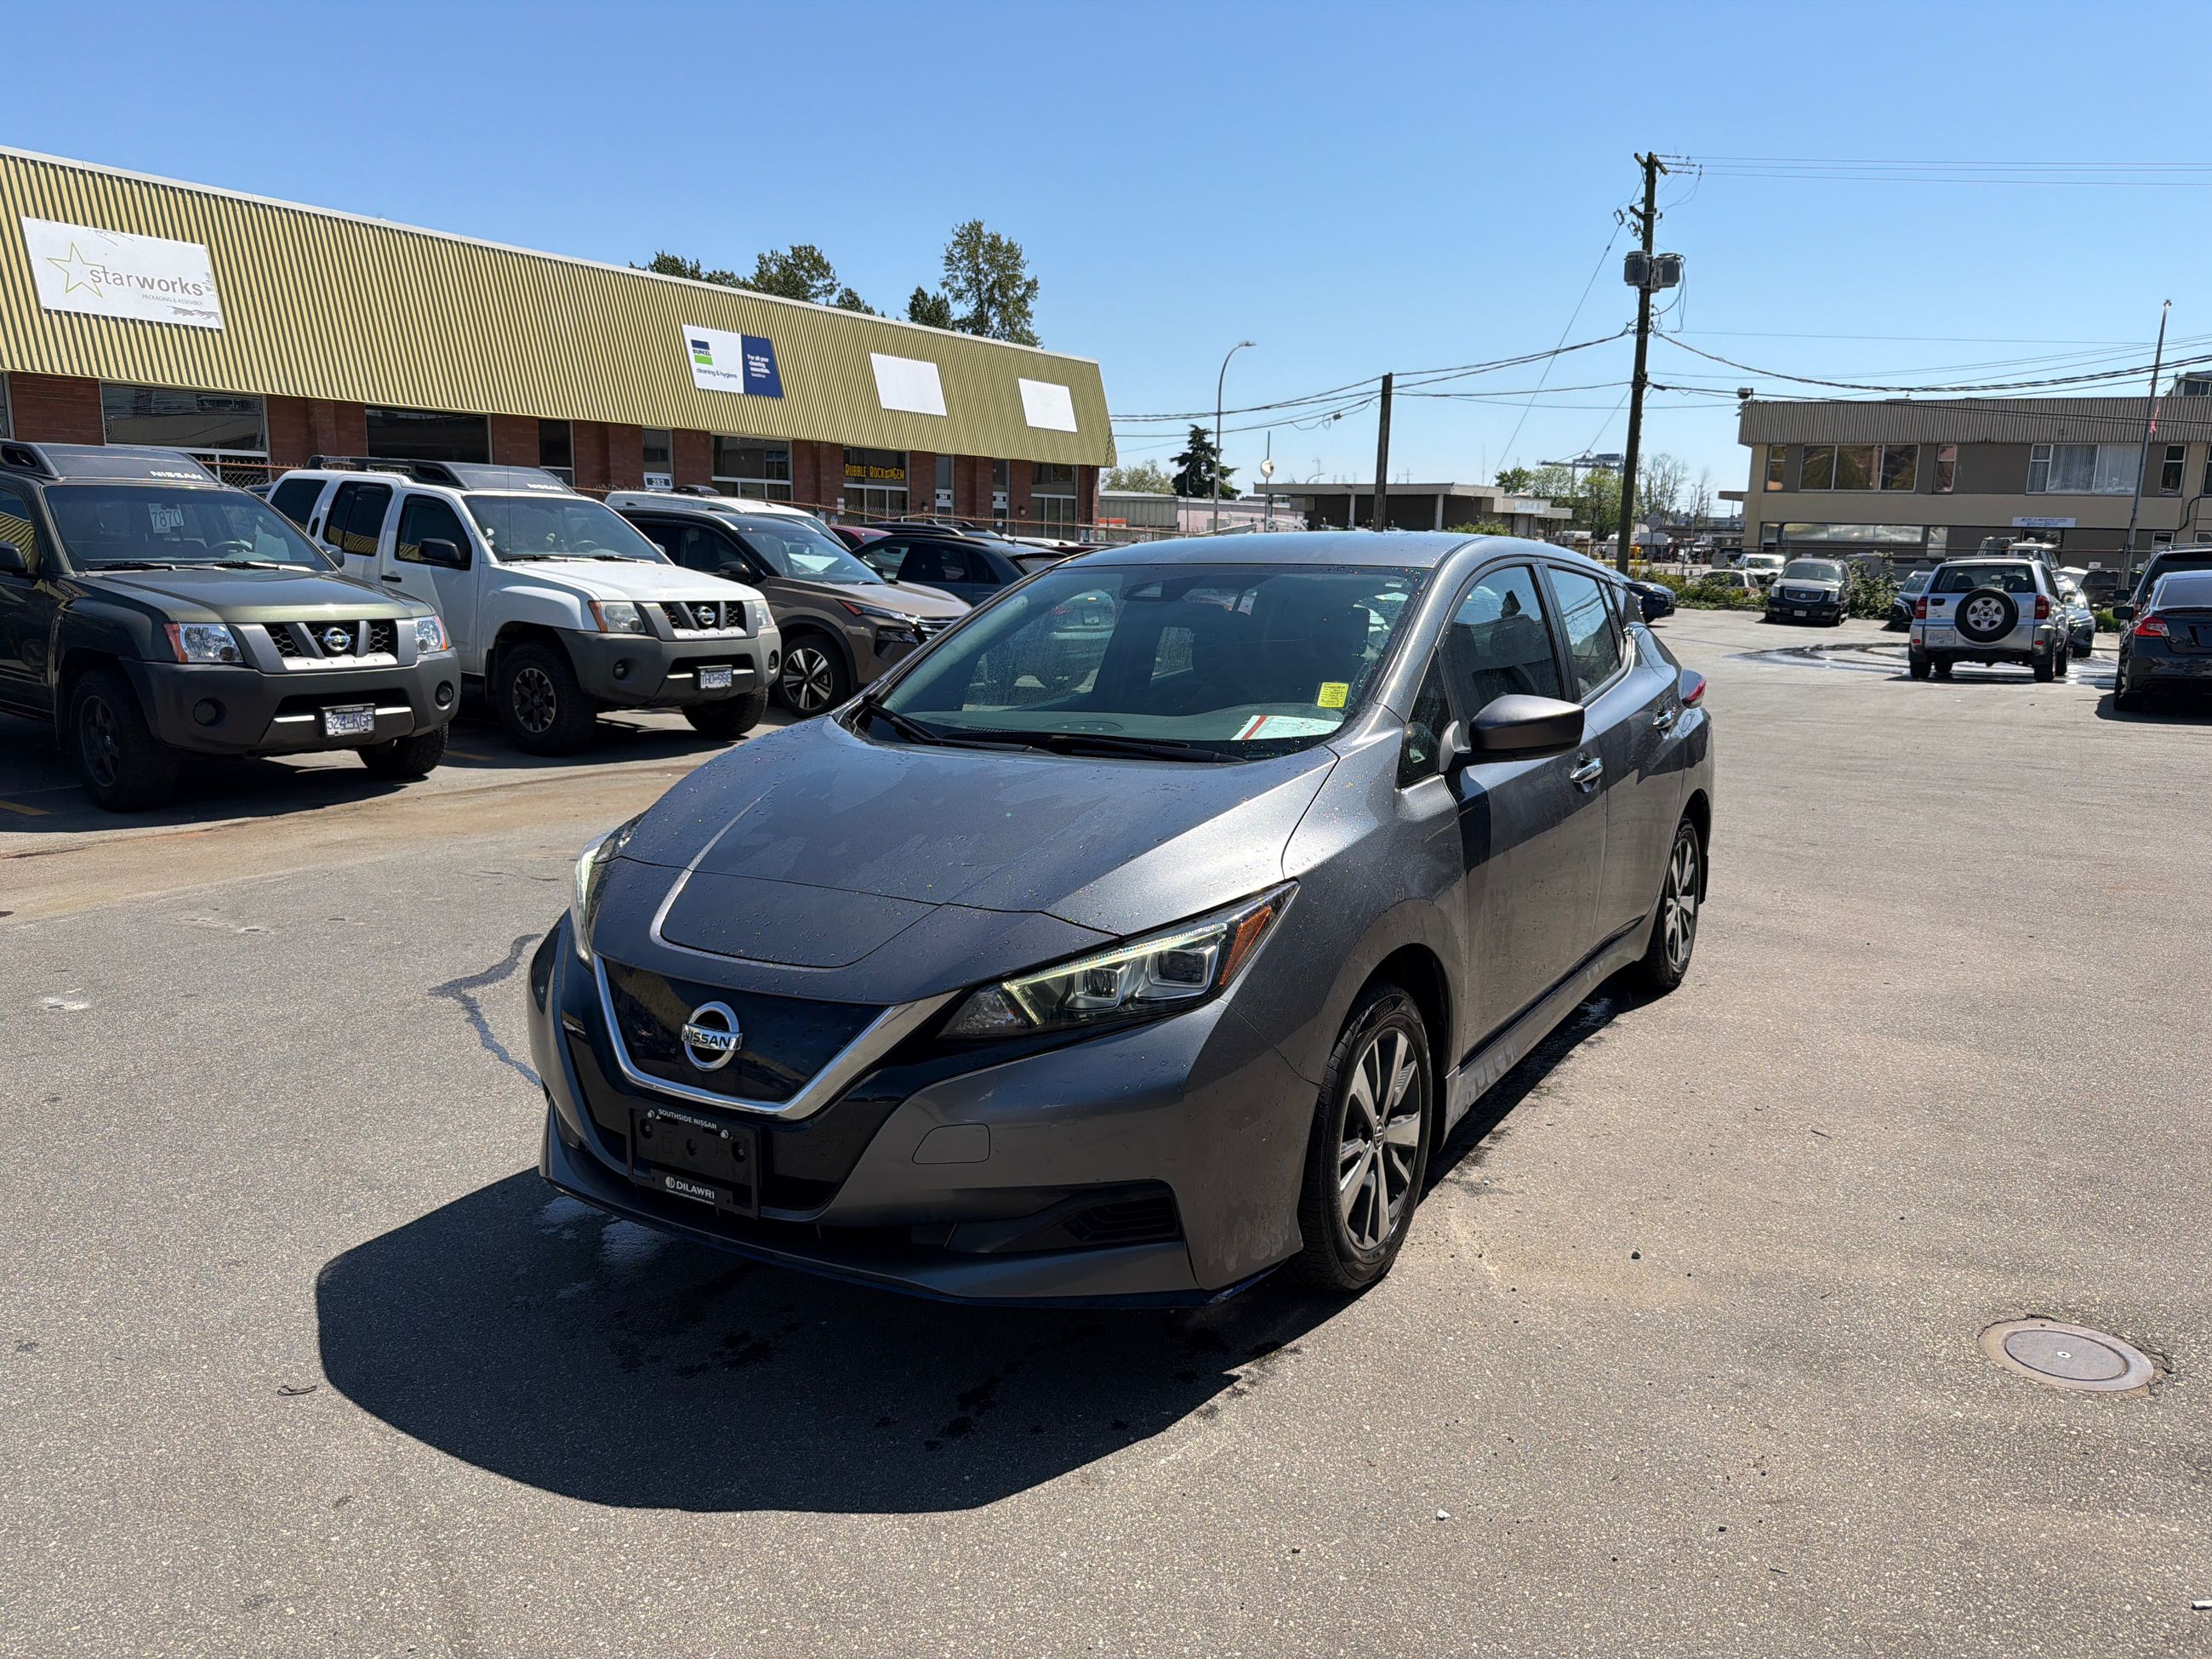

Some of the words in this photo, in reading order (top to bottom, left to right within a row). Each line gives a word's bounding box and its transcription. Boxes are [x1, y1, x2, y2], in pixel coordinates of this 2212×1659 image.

[89, 266, 203, 297] starworks
[141, 294, 173, 303] PACKAGING
[696, 368, 715, 377] cleaning
[150, 470, 204, 480] NISSAN
[845, 463, 867, 476] RUBBLE
[151, 510, 182, 527] 7870
[682, 1029, 732, 1047] NISSAN
[658, 1109, 693, 1123] SOUTHSIDE
[693, 1118, 717, 1130] NISSAN
[676, 1180, 715, 1200] DILAWRI
